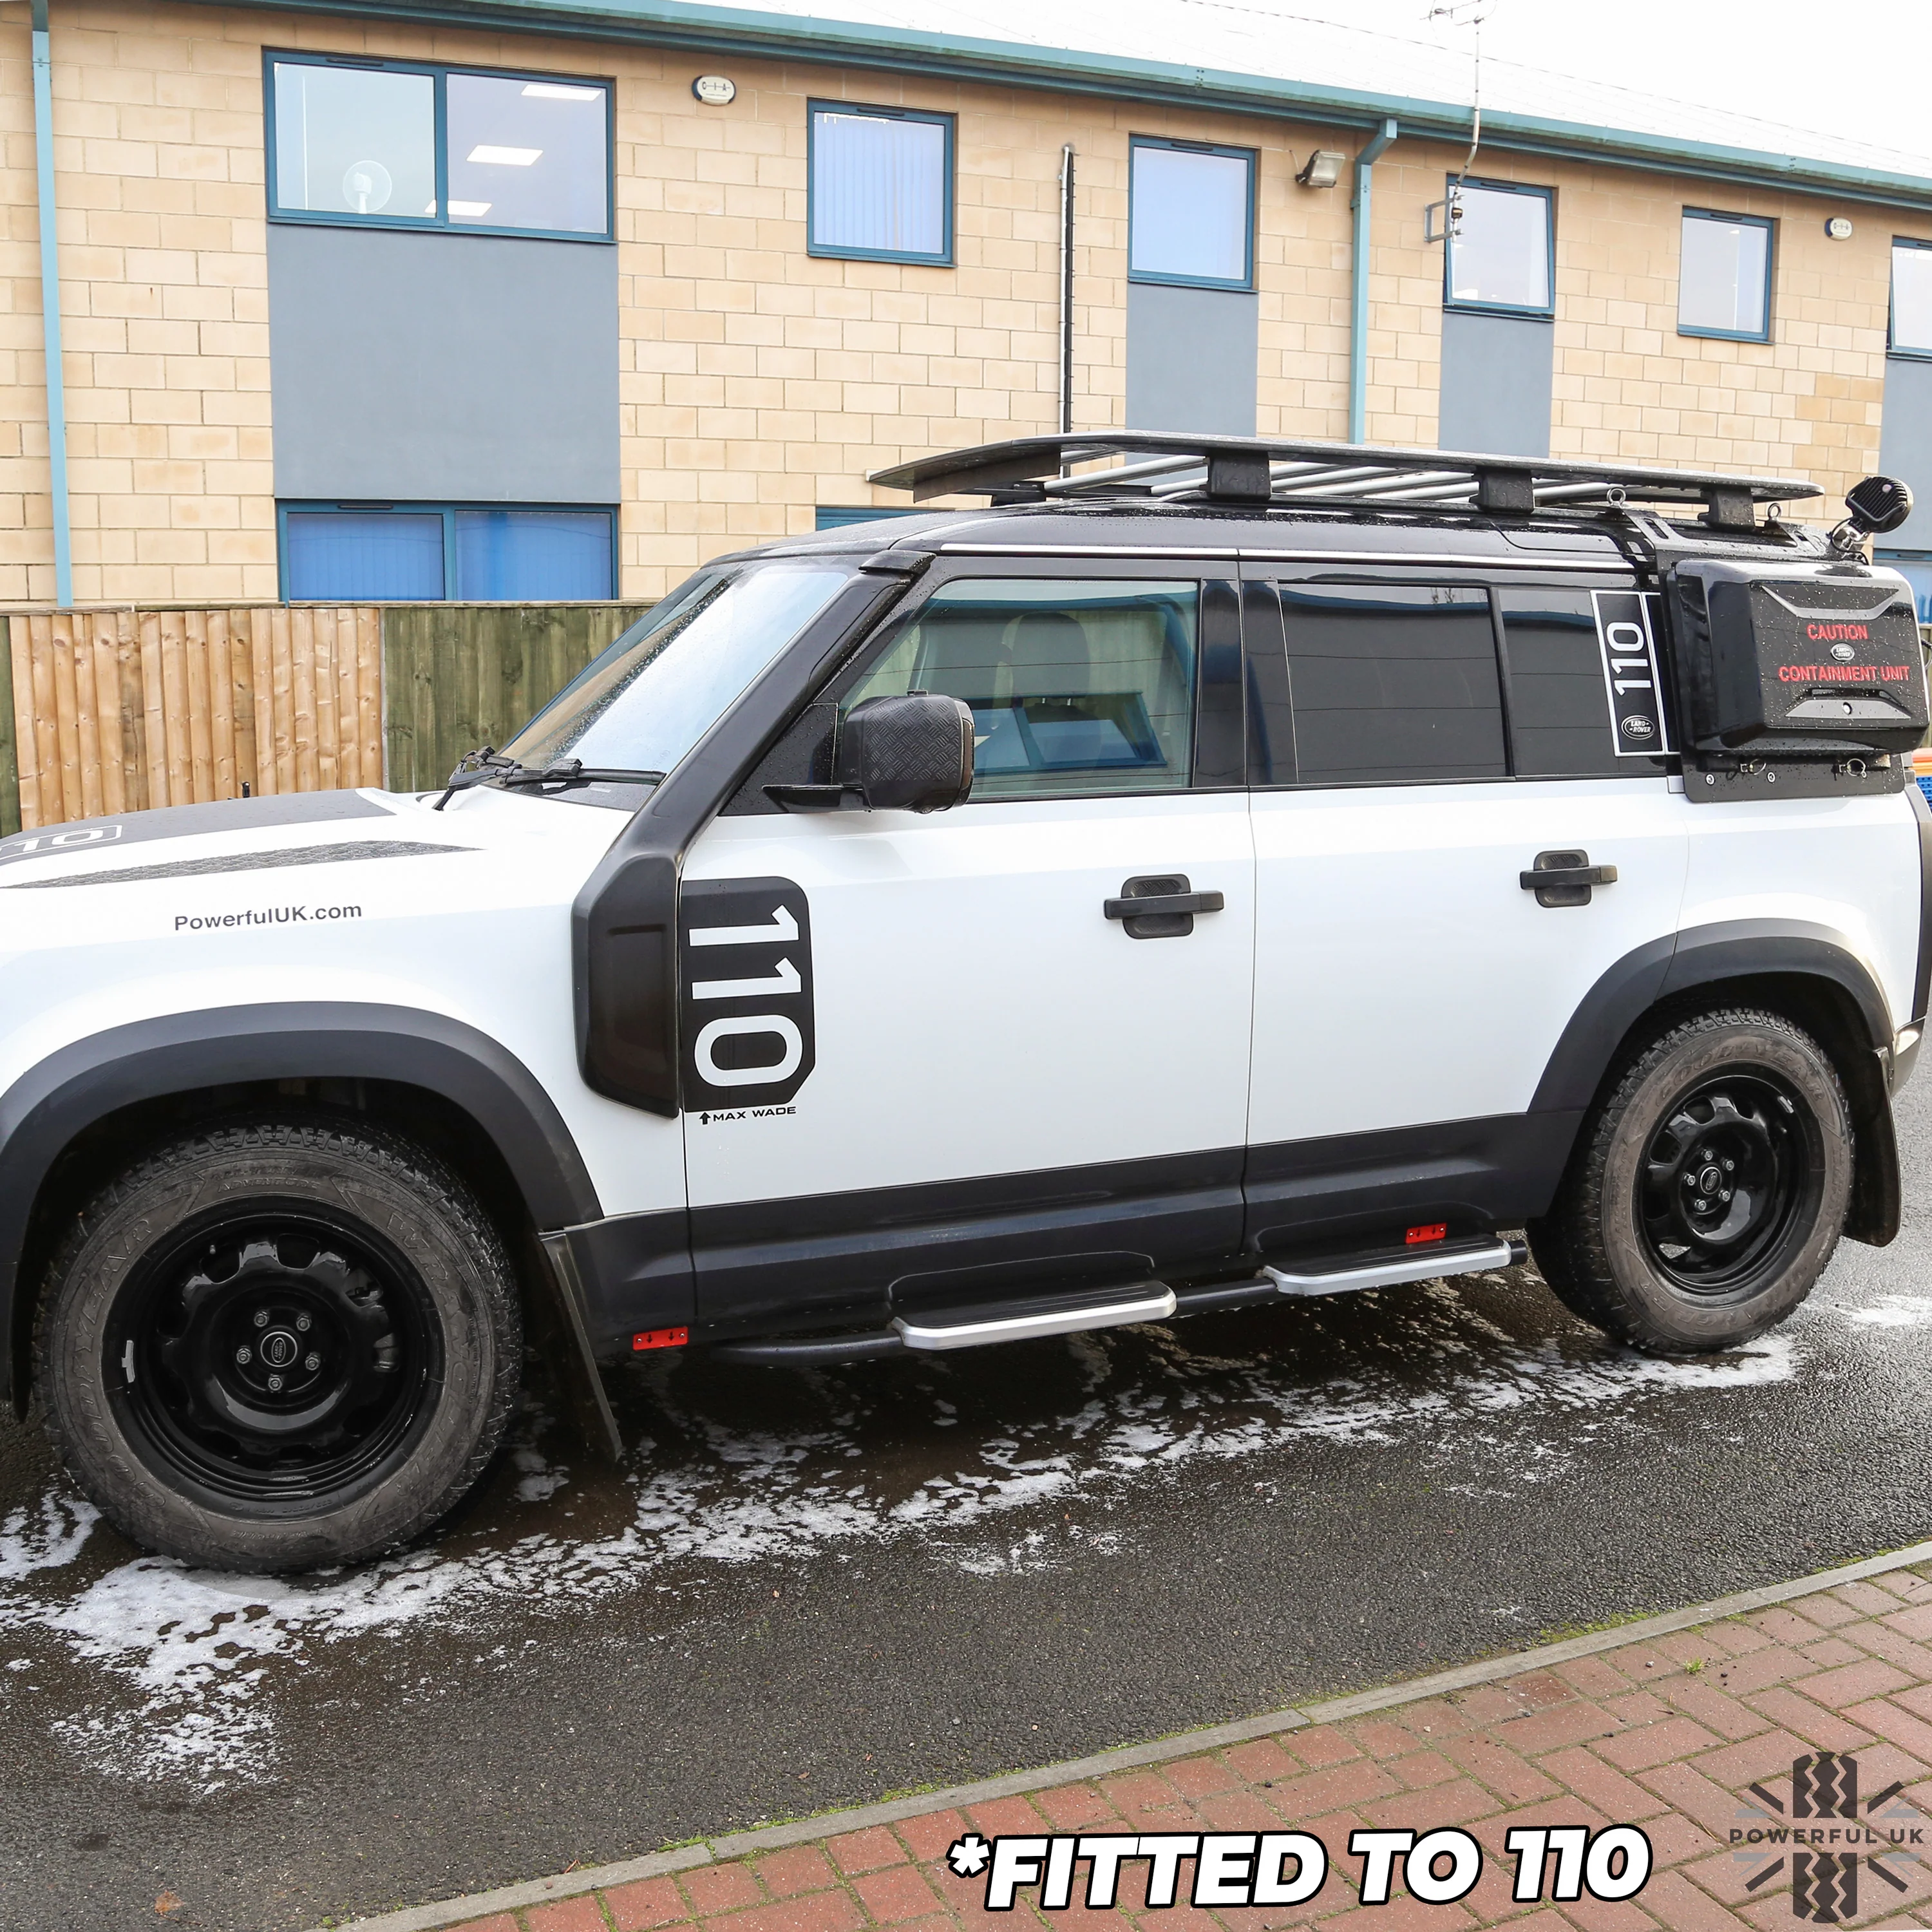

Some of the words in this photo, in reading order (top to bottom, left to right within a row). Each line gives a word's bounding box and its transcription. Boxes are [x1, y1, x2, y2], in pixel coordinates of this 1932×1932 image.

[1806, 623, 1868, 640] CAUTION
[1606, 621, 1652, 697] 110
[1778, 665, 1877, 682] CONTAINMENT
[1880, 665, 1910, 681] UNIT
[175, 905, 363, 931] PowerfulUK.com
[688, 904, 804, 1088] 110
[713, 1110, 746, 1122] MAX
[752, 1106, 797, 1118] WADE
